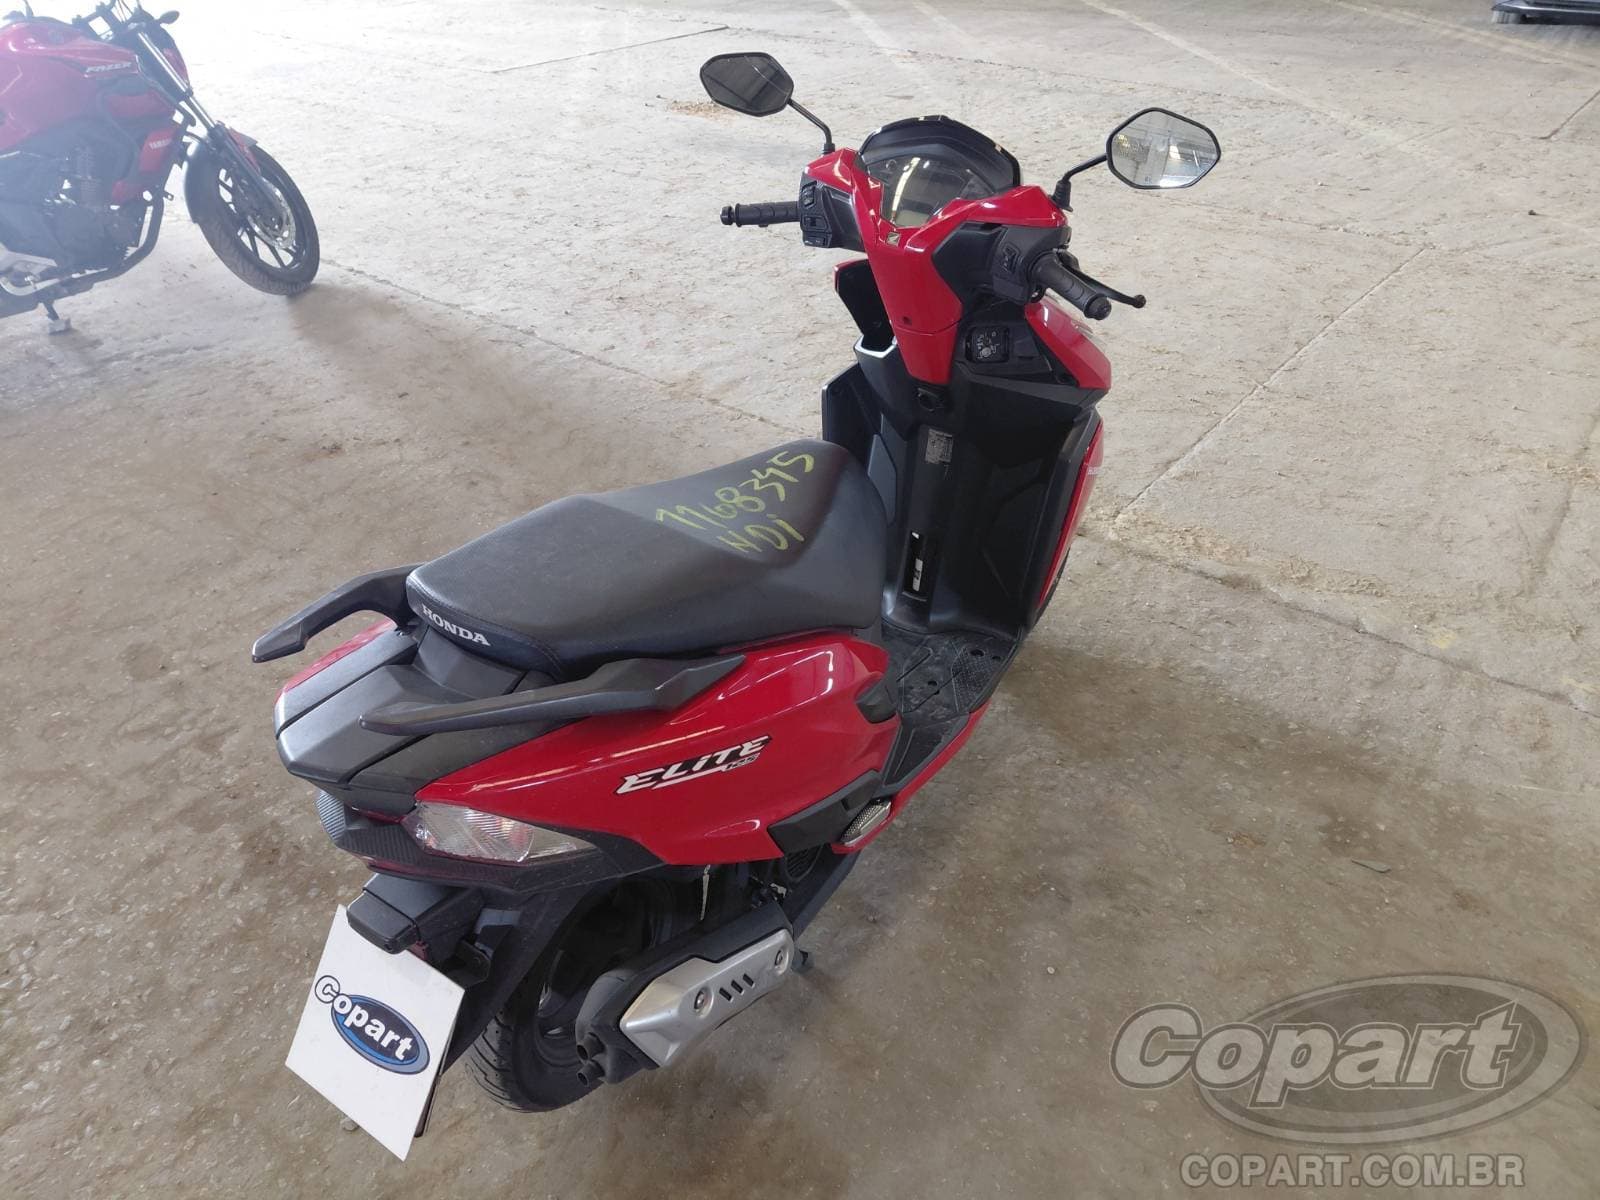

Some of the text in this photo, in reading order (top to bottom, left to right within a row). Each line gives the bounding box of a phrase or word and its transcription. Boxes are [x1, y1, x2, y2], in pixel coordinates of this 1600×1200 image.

[421, 603, 491, 647] HONDA
[616, 735, 770, 794] ELITE
[315, 975, 414, 1061] Copart
